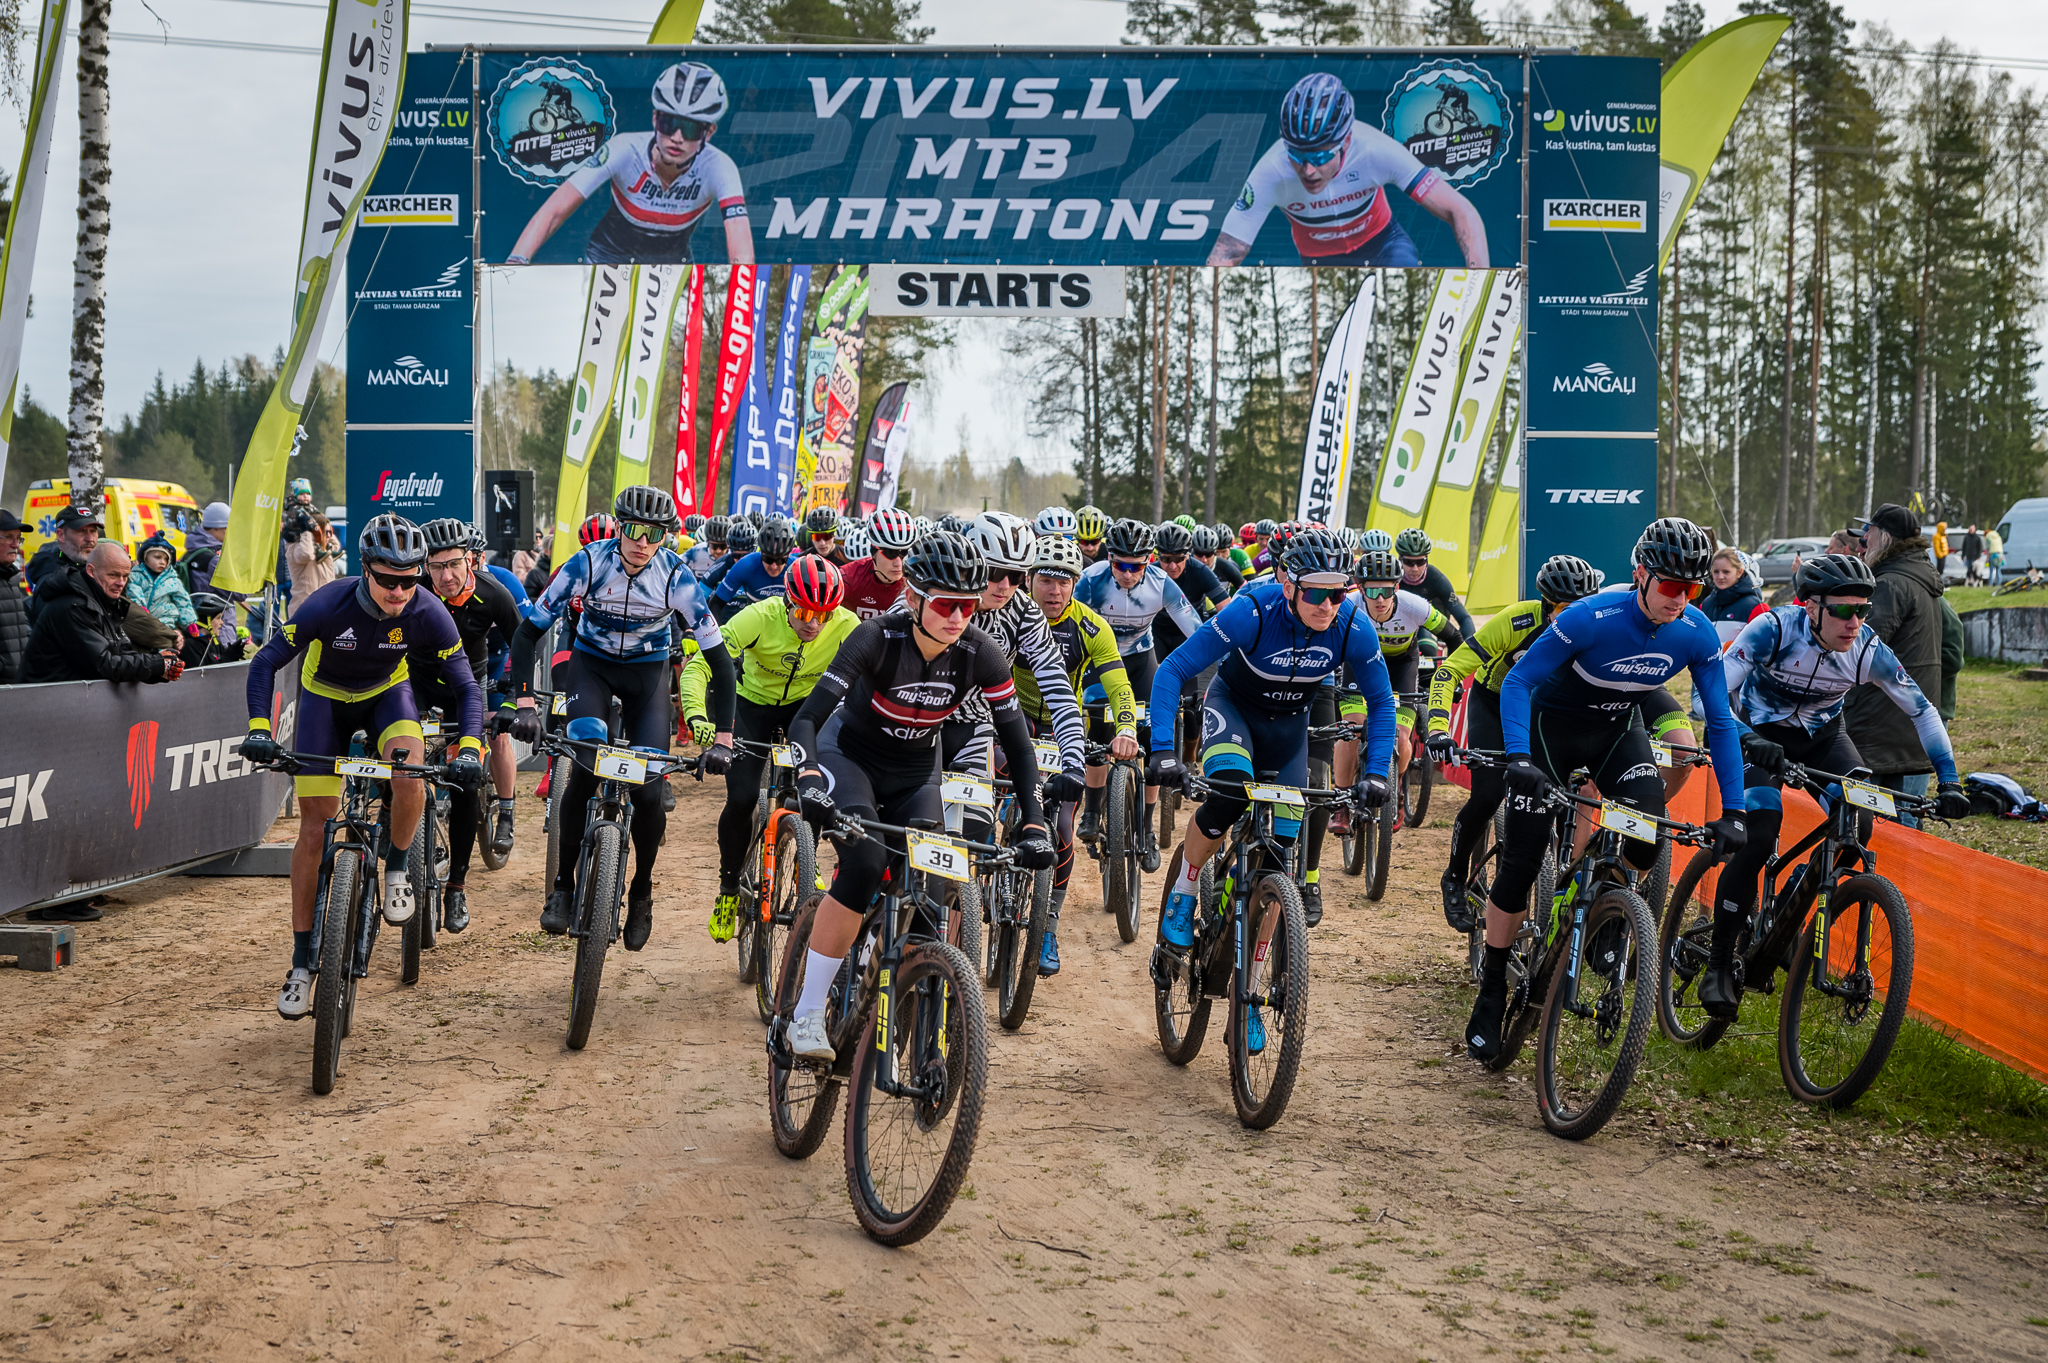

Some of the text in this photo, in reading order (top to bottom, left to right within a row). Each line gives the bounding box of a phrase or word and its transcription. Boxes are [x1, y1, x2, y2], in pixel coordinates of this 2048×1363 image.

[807, 76, 1180, 120] VIVUS.LV
[415, 136, 434, 146] tam
[436, 135, 469, 146] kustas
[514, 134, 552, 153] MTB
[1409, 136, 1447, 155] MTB
[1545, 140, 1656, 152] Kas kustina, tam kustas
[550, 142, 595, 161] 2024
[905, 137, 1071, 180] MTB
[1445, 145, 1491, 165] 2024
[363, 198, 453, 213] KÄRCHER
[1549, 202, 1641, 218] KÄRCHER
[764, 197, 1215, 241] MARATONS
[355, 290, 462, 298] LATVIJAS VALSTS MEŽI
[896, 270, 1092, 309] STARTS
[1539, 296, 1587, 304] LATVIJAS
[1589, 296, 1623, 304] VALSTS
[367, 369, 449, 387] MANGAĻI
[1553, 376, 1635, 395] MANGAĻI
[370, 470, 443, 501] Segafredo
[1545, 489, 1644, 504] TREK
[1610, 661, 1669, 677] mySport
[896, 690, 952, 707] mySport
[1119, 690, 1131, 711] BIKE
[1430, 682, 1444, 706] BIKE
[357, 766, 376, 774] 10
[618, 762, 629, 774] 6
[1623, 769, 1658, 783] mySport
[963, 786, 974, 798] 4
[1867, 794, 1878, 806] 3
[1625, 819, 1638, 832] 2
[929, 850, 953, 869] 39
